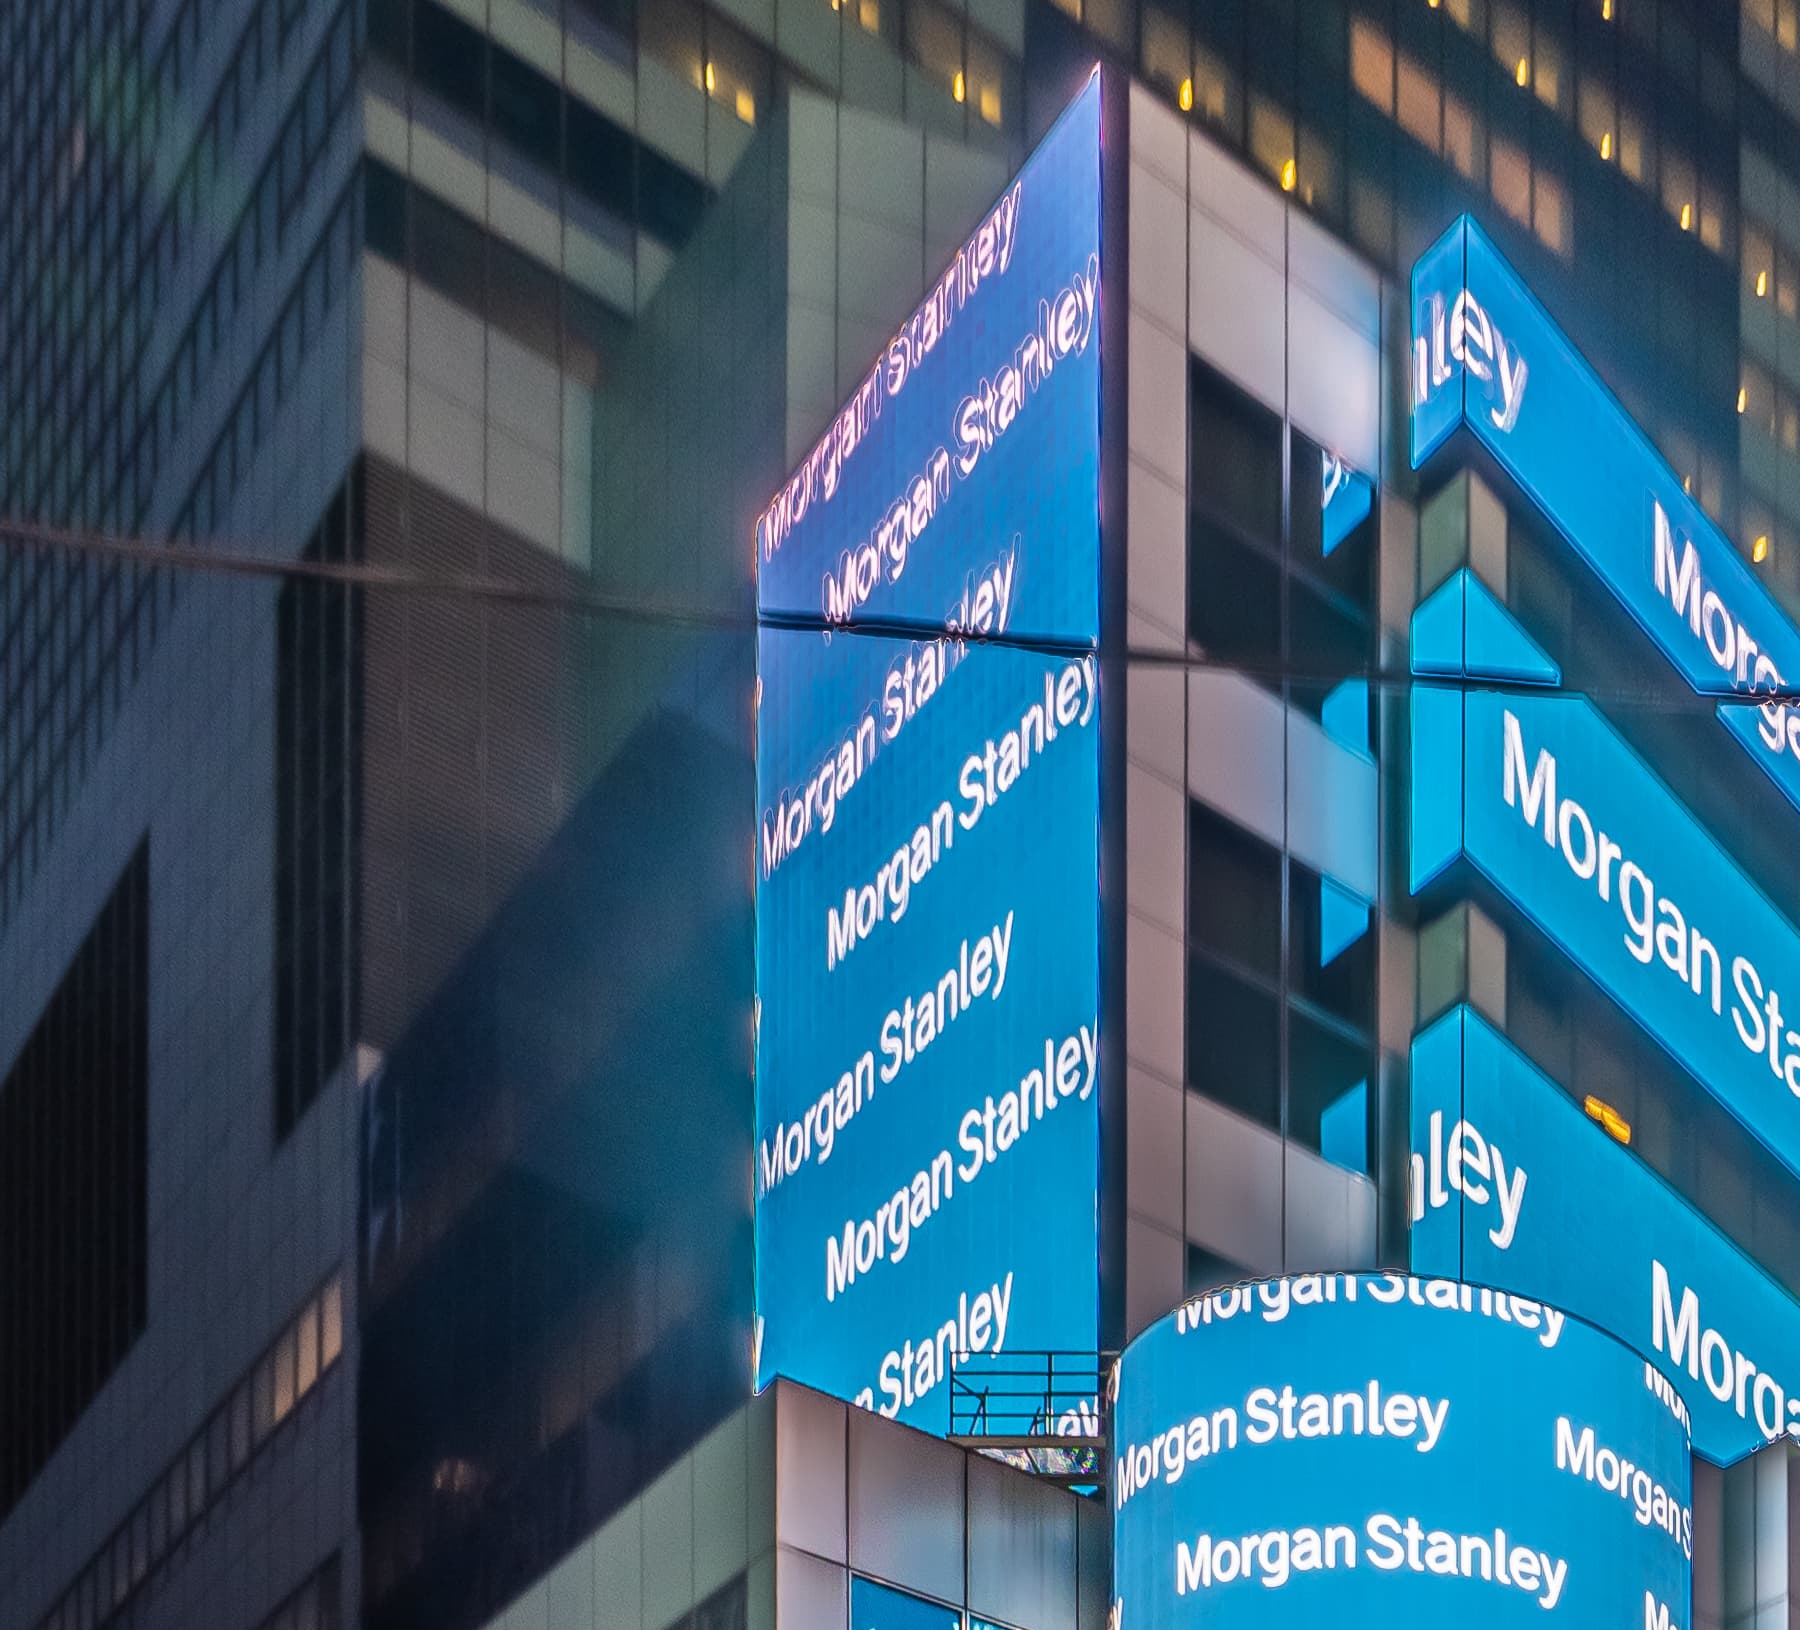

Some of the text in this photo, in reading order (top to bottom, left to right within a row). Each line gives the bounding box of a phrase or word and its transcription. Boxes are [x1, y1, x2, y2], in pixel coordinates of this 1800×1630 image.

[765, 179, 1022, 562] Morgan Stanley
[822, 253, 1098, 645] Morgan Stanley
[761, 532, 1021, 882] Morgan Stanley
[827, 650, 1098, 971] Morgan Stanley
[1503, 709, 1721, 1015] Morgan
[759, 909, 1014, 1200] Morgan Stanley
[826, 1014, 1097, 1301] Morgan Stanley
[879, 1271, 1014, 1420] Stanley
[1116, 1406, 1237, 1509] Morgan
[1246, 1380, 1450, 1452] Stanley
[1556, 1417, 1682, 1538] Morgan
[1177, 1514, 1567, 1609] Morgan Stanley
